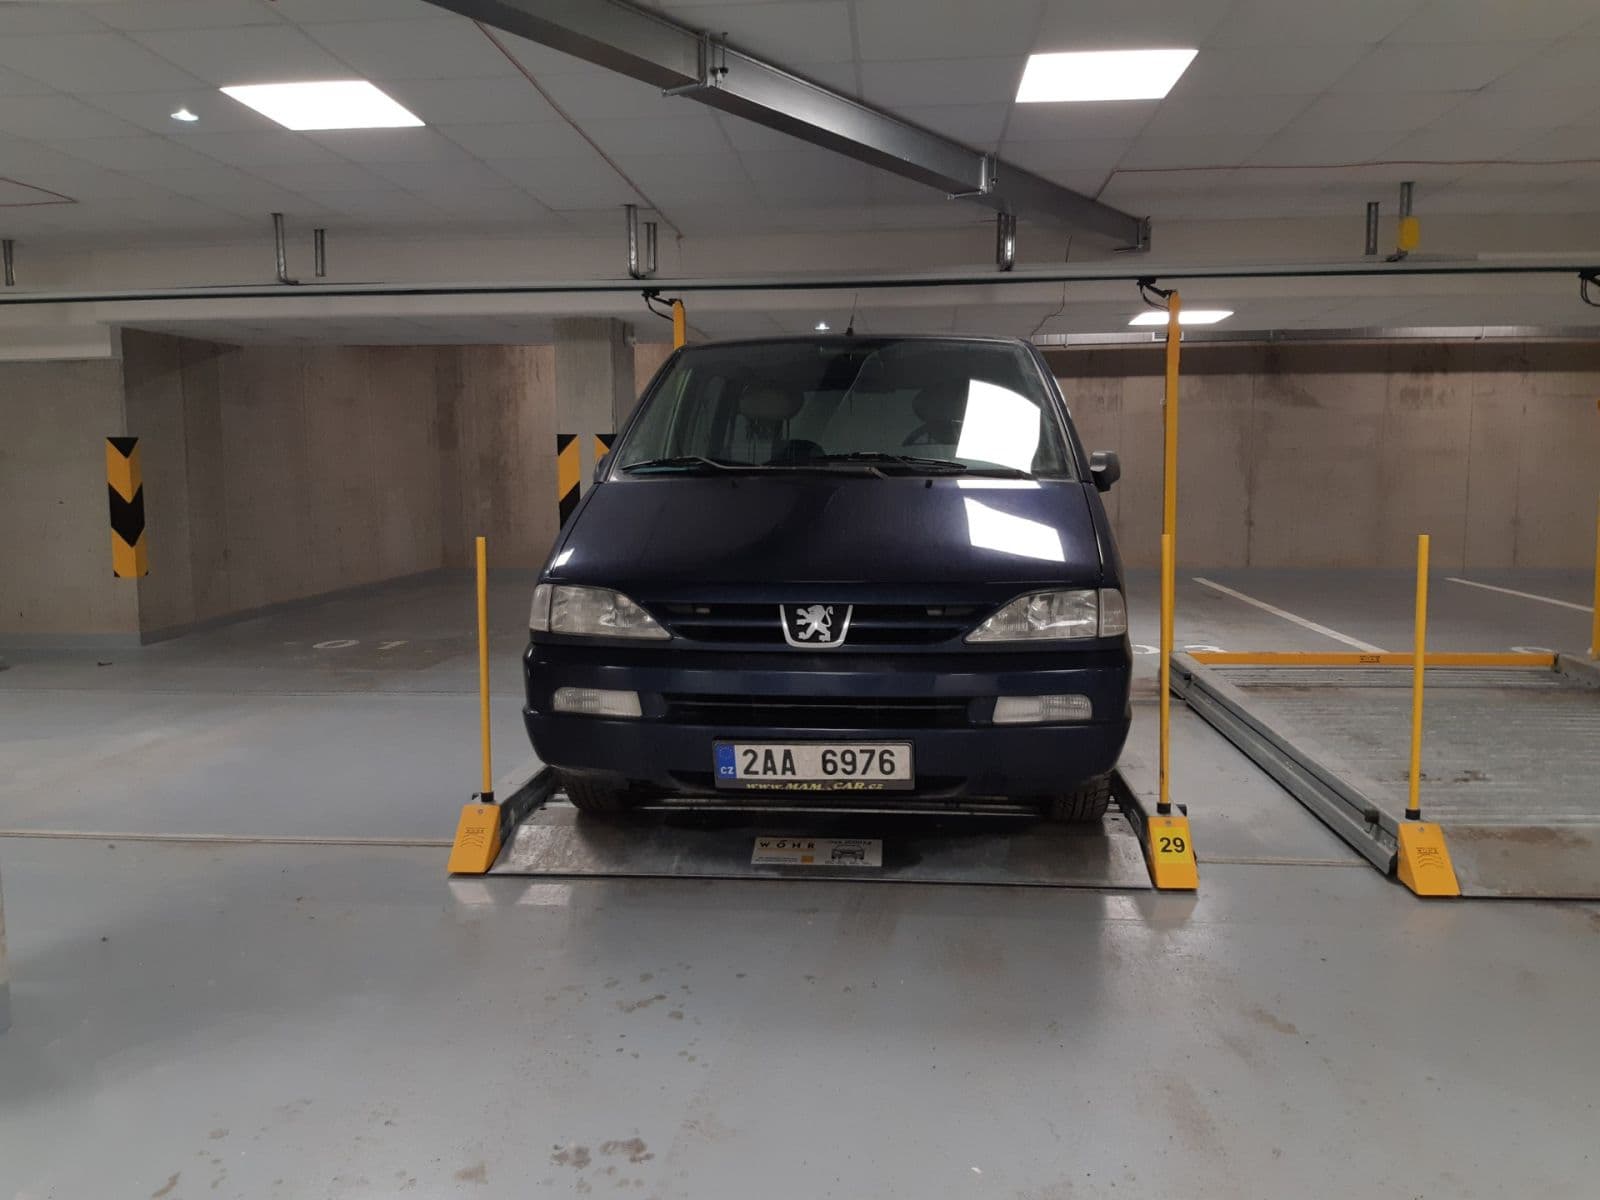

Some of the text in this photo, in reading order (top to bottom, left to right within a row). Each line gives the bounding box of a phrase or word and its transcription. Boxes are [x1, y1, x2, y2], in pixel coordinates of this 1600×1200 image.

[720, 766, 735, 775] CZ
[742, 749, 896, 776] 2AA 6976
[1160, 836, 1186, 853] 29
